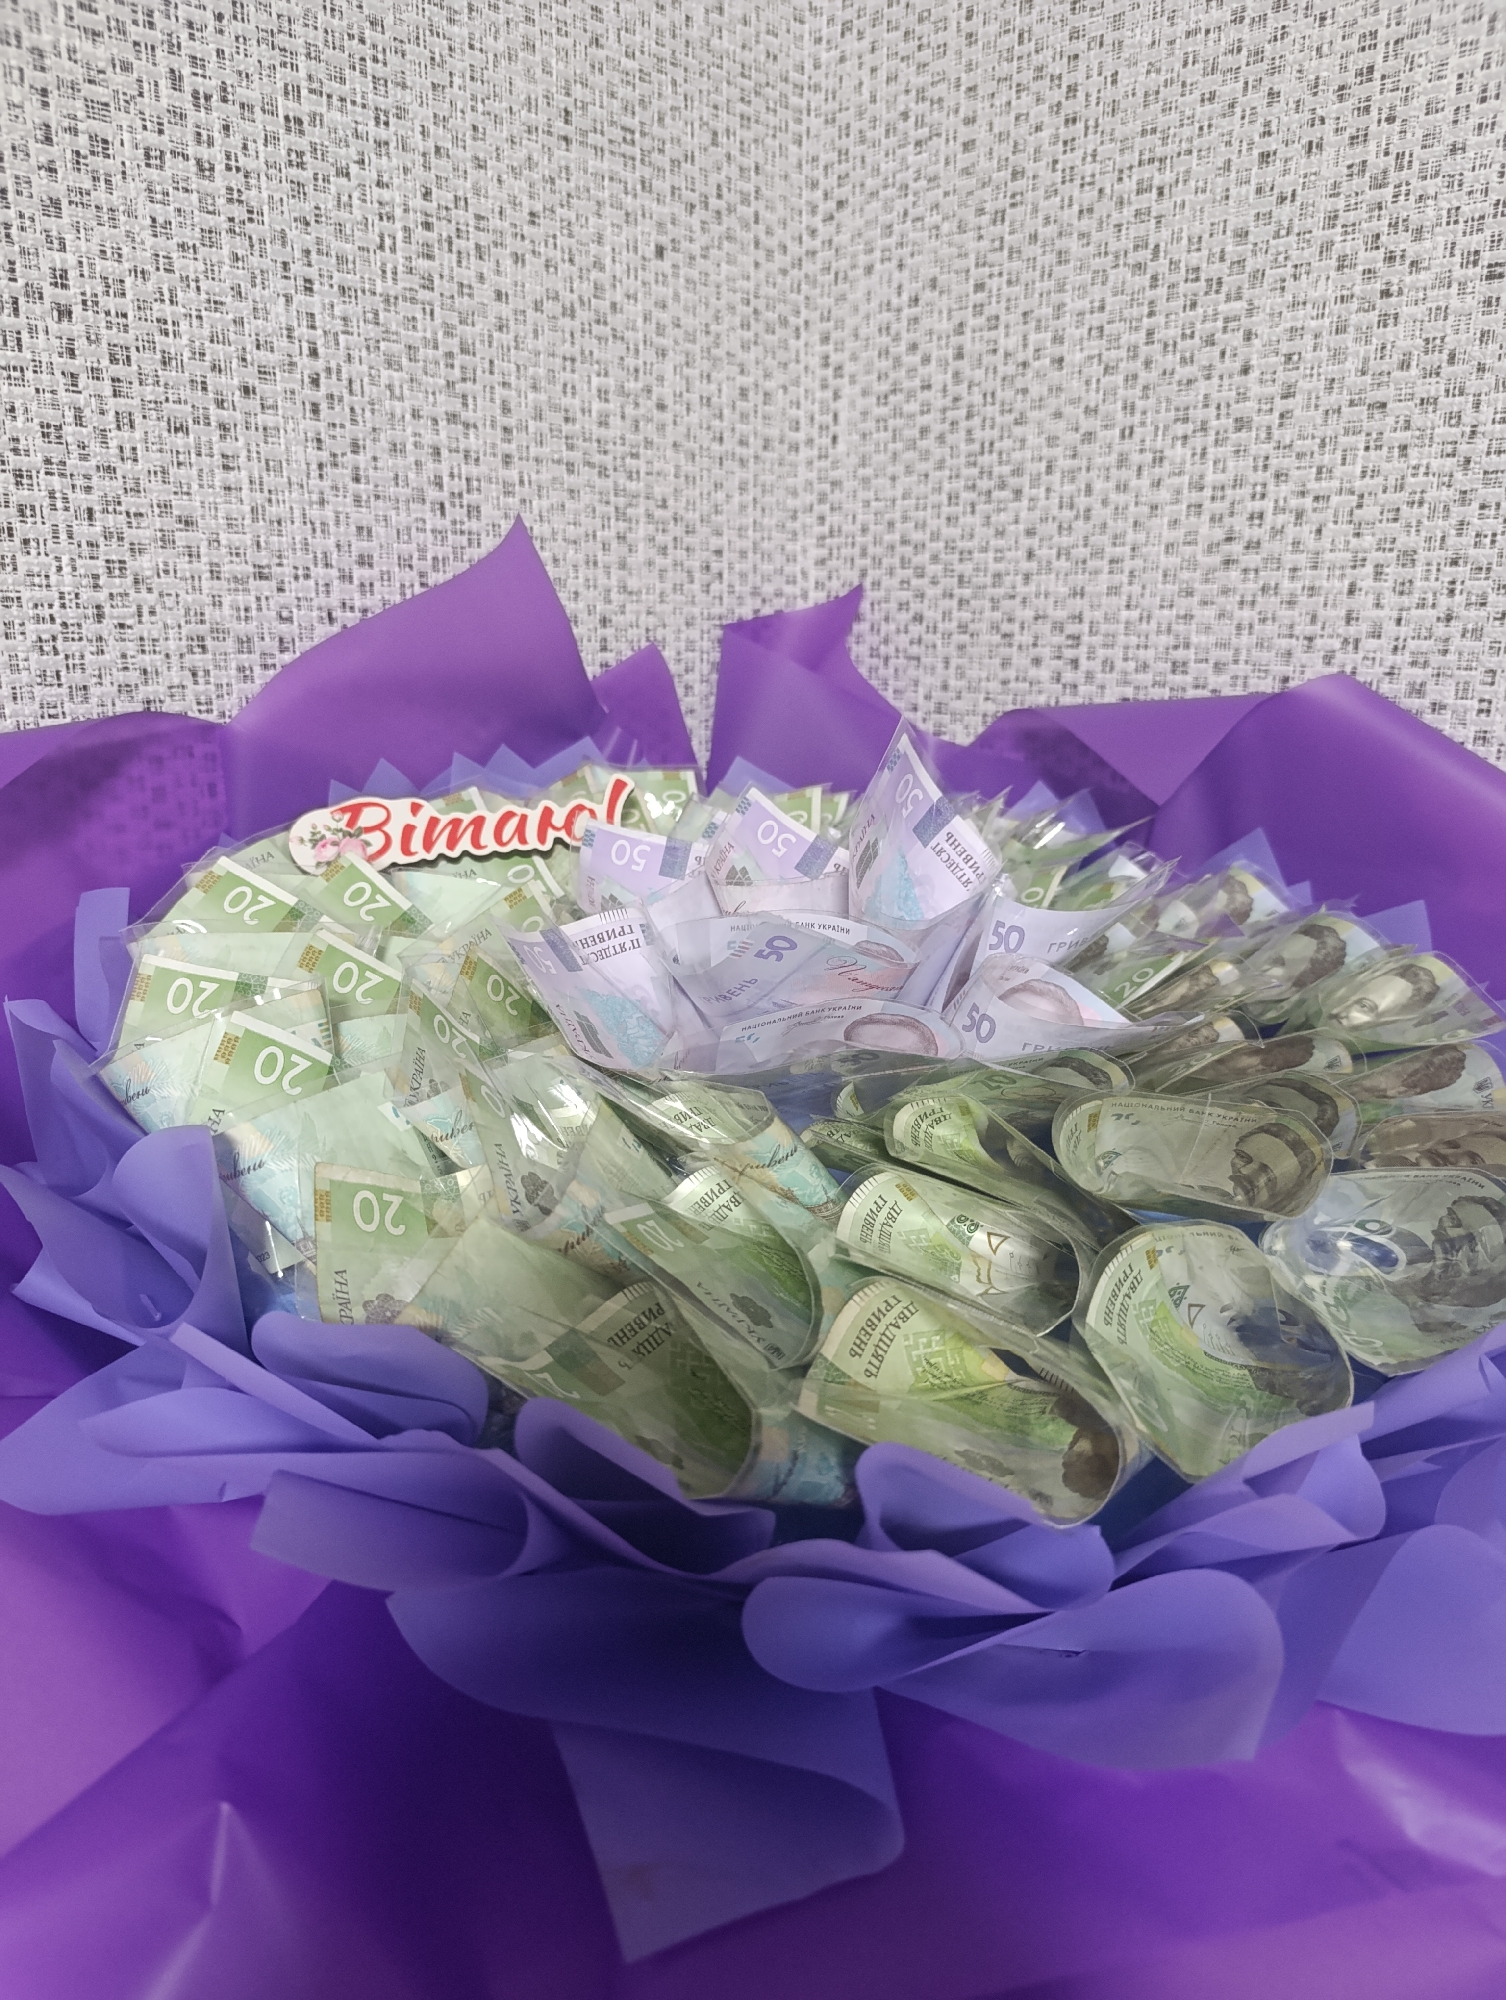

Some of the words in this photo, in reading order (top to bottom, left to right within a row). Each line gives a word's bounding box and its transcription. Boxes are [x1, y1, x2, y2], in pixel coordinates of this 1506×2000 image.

[896, 773, 924, 818] 50
[611, 839, 651, 872] 50
[758, 820, 796, 858] 50
[930, 842, 973, 892] 'ЯТДЕСЯТ
[223, 885, 276, 925] 20
[343, 881, 392, 922] 20
[753, 935, 798, 962] 50
[817, 922, 851, 936] УКРАЇНИ
[989, 919, 1025, 954] 50
[1047, 936, 1088, 954] ГРИВ
[523, 945, 557, 975] 50
[167, 977, 220, 1019] 20
[333, 961, 384, 1005] 20
[486, 974, 521, 1016] 20
[1114, 967, 1154, 999] 20
[804, 1007, 827, 1018] БАНК
[826, 1004, 863, 1014] УКРАЇНИ
[962, 1002, 996, 1044] 50
[434, 1014, 468, 1059] 20
[254, 1045, 313, 1096] 20
[910, 1106, 945, 1148] ГРИВЕНЬ
[493, 1142, 523, 1215] УКРАЇНА
[353, 1189, 406, 1236] 20
[859, 1194, 889, 1246] ГРИВЕНЬ
[636, 1219, 685, 1252] 20
[1103, 1262, 1136, 1328] ГРИВЕНЬ
[1115, 1268, 1144, 1346] ДВАДЦЯТЬ
[848, 1294, 903, 1360] ГРИВЕНЬ
[863, 1300, 920, 1380] ДВАДЦЯТЬ
